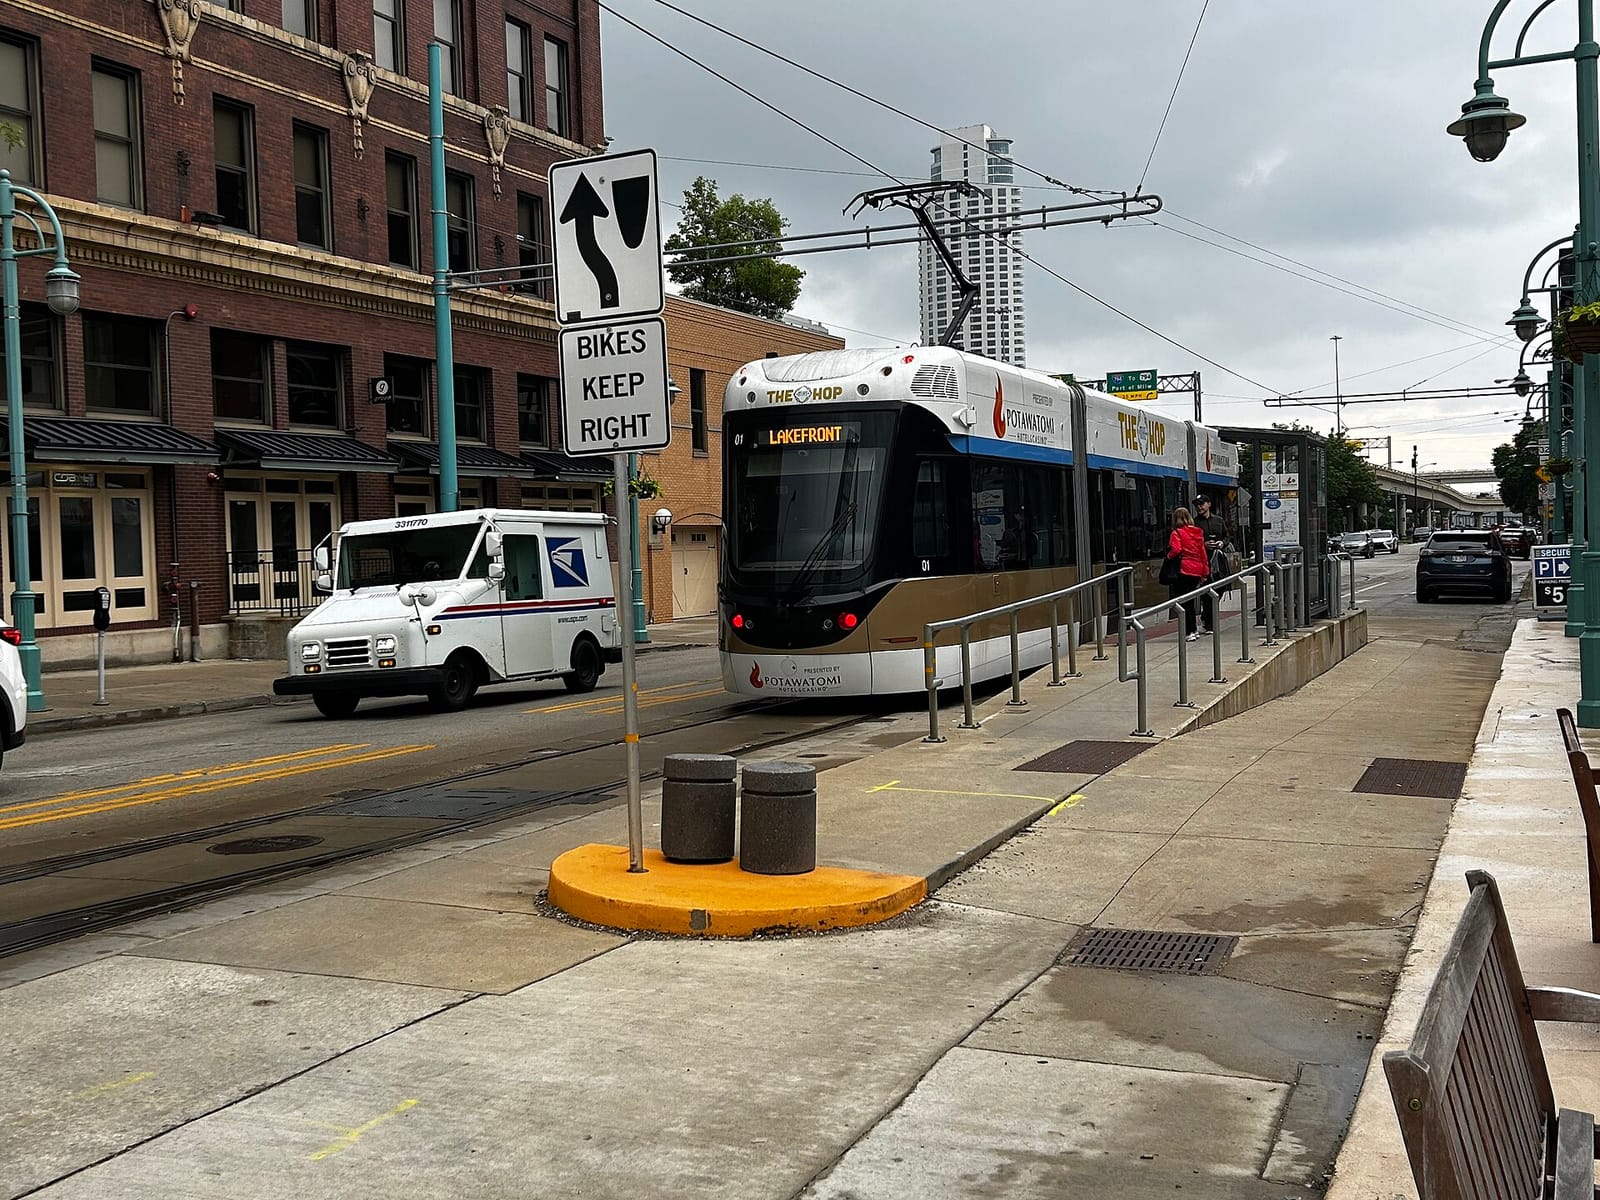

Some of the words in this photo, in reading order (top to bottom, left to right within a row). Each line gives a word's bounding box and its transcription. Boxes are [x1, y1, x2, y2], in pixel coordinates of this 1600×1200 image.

[577, 329, 646, 360] BIKES
[582, 372, 645, 401] KEEP
[767, 390, 793, 404] THE
[812, 386, 843, 401] HOP
[580, 413, 652, 443] RIGHT
[1006, 408, 1055, 435] POTAWATOMI
[734, 434, 744, 446] 01
[769, 426, 842, 445] LAKEFRONT
[1118, 411, 1138, 451] THE
[1148, 420, 1166, 456] HOP
[395, 518, 428, 528] 3311770
[1540, 548, 1571, 557] secure
[921, 560, 930, 571] 01
[1539, 561, 1550, 575] P
[1544, 586, 1564, 603] $5
[803, 666, 832, 674] PRESENTED
[764, 676, 841, 687] POTAWATOMI
